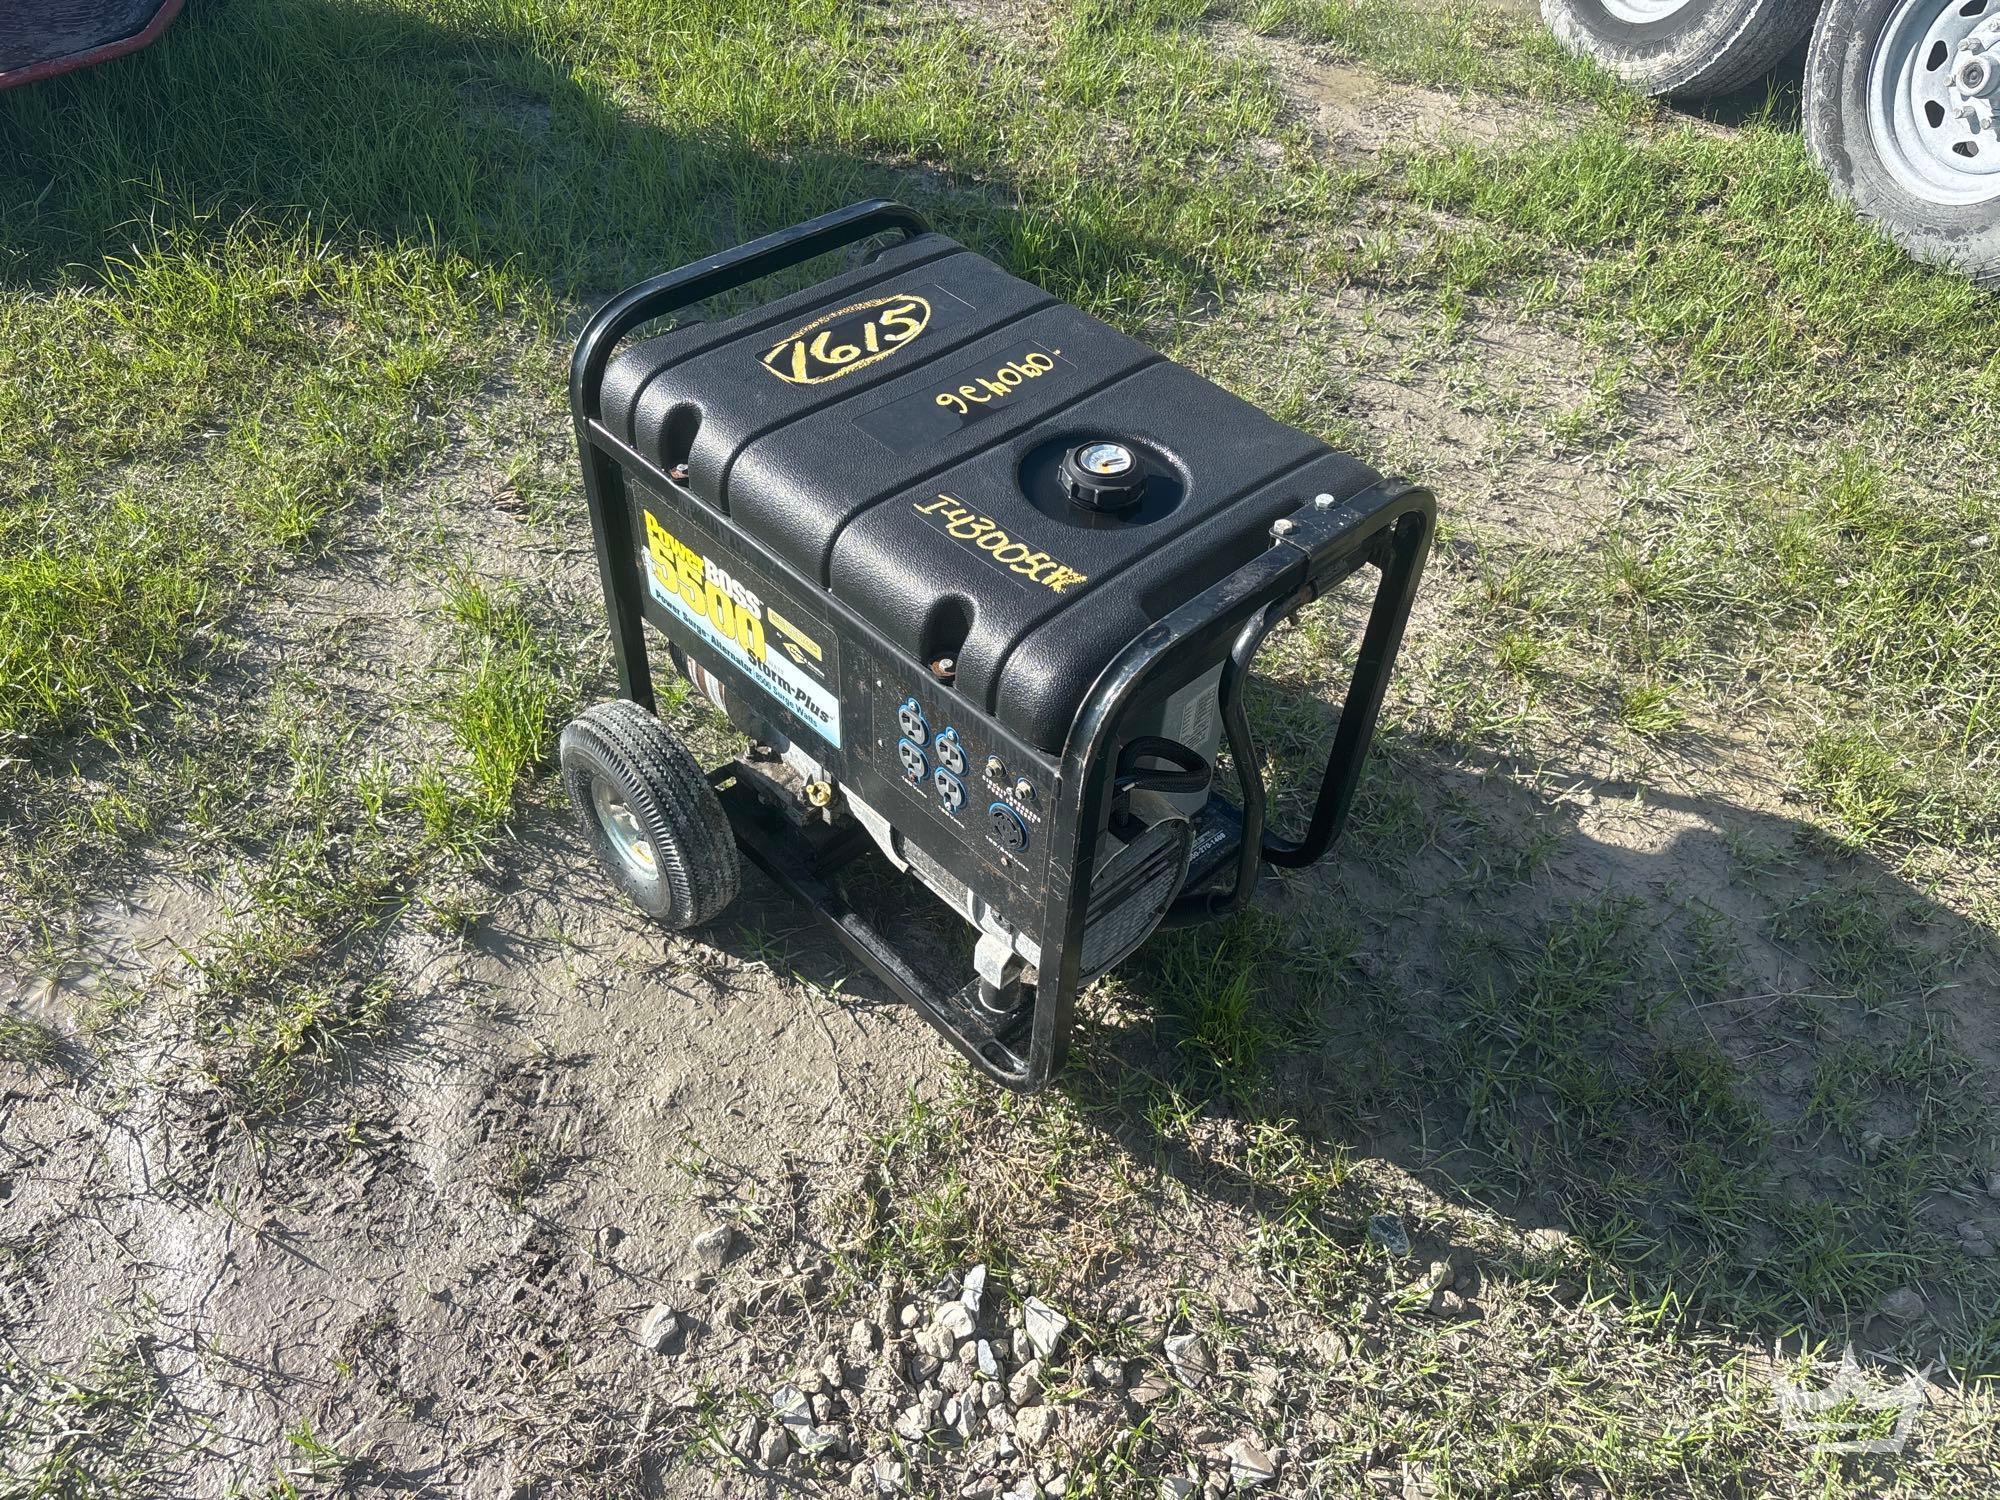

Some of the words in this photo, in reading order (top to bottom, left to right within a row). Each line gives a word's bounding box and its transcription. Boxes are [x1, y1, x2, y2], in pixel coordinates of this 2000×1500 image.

[648, 535, 767, 663] 5500
[655, 590, 681, 617] Power
[683, 610, 707, 638] Surge
[710, 635, 754, 674] Alternator
[772, 683, 795, 709] Surge
[795, 705, 819, 728] Watts
